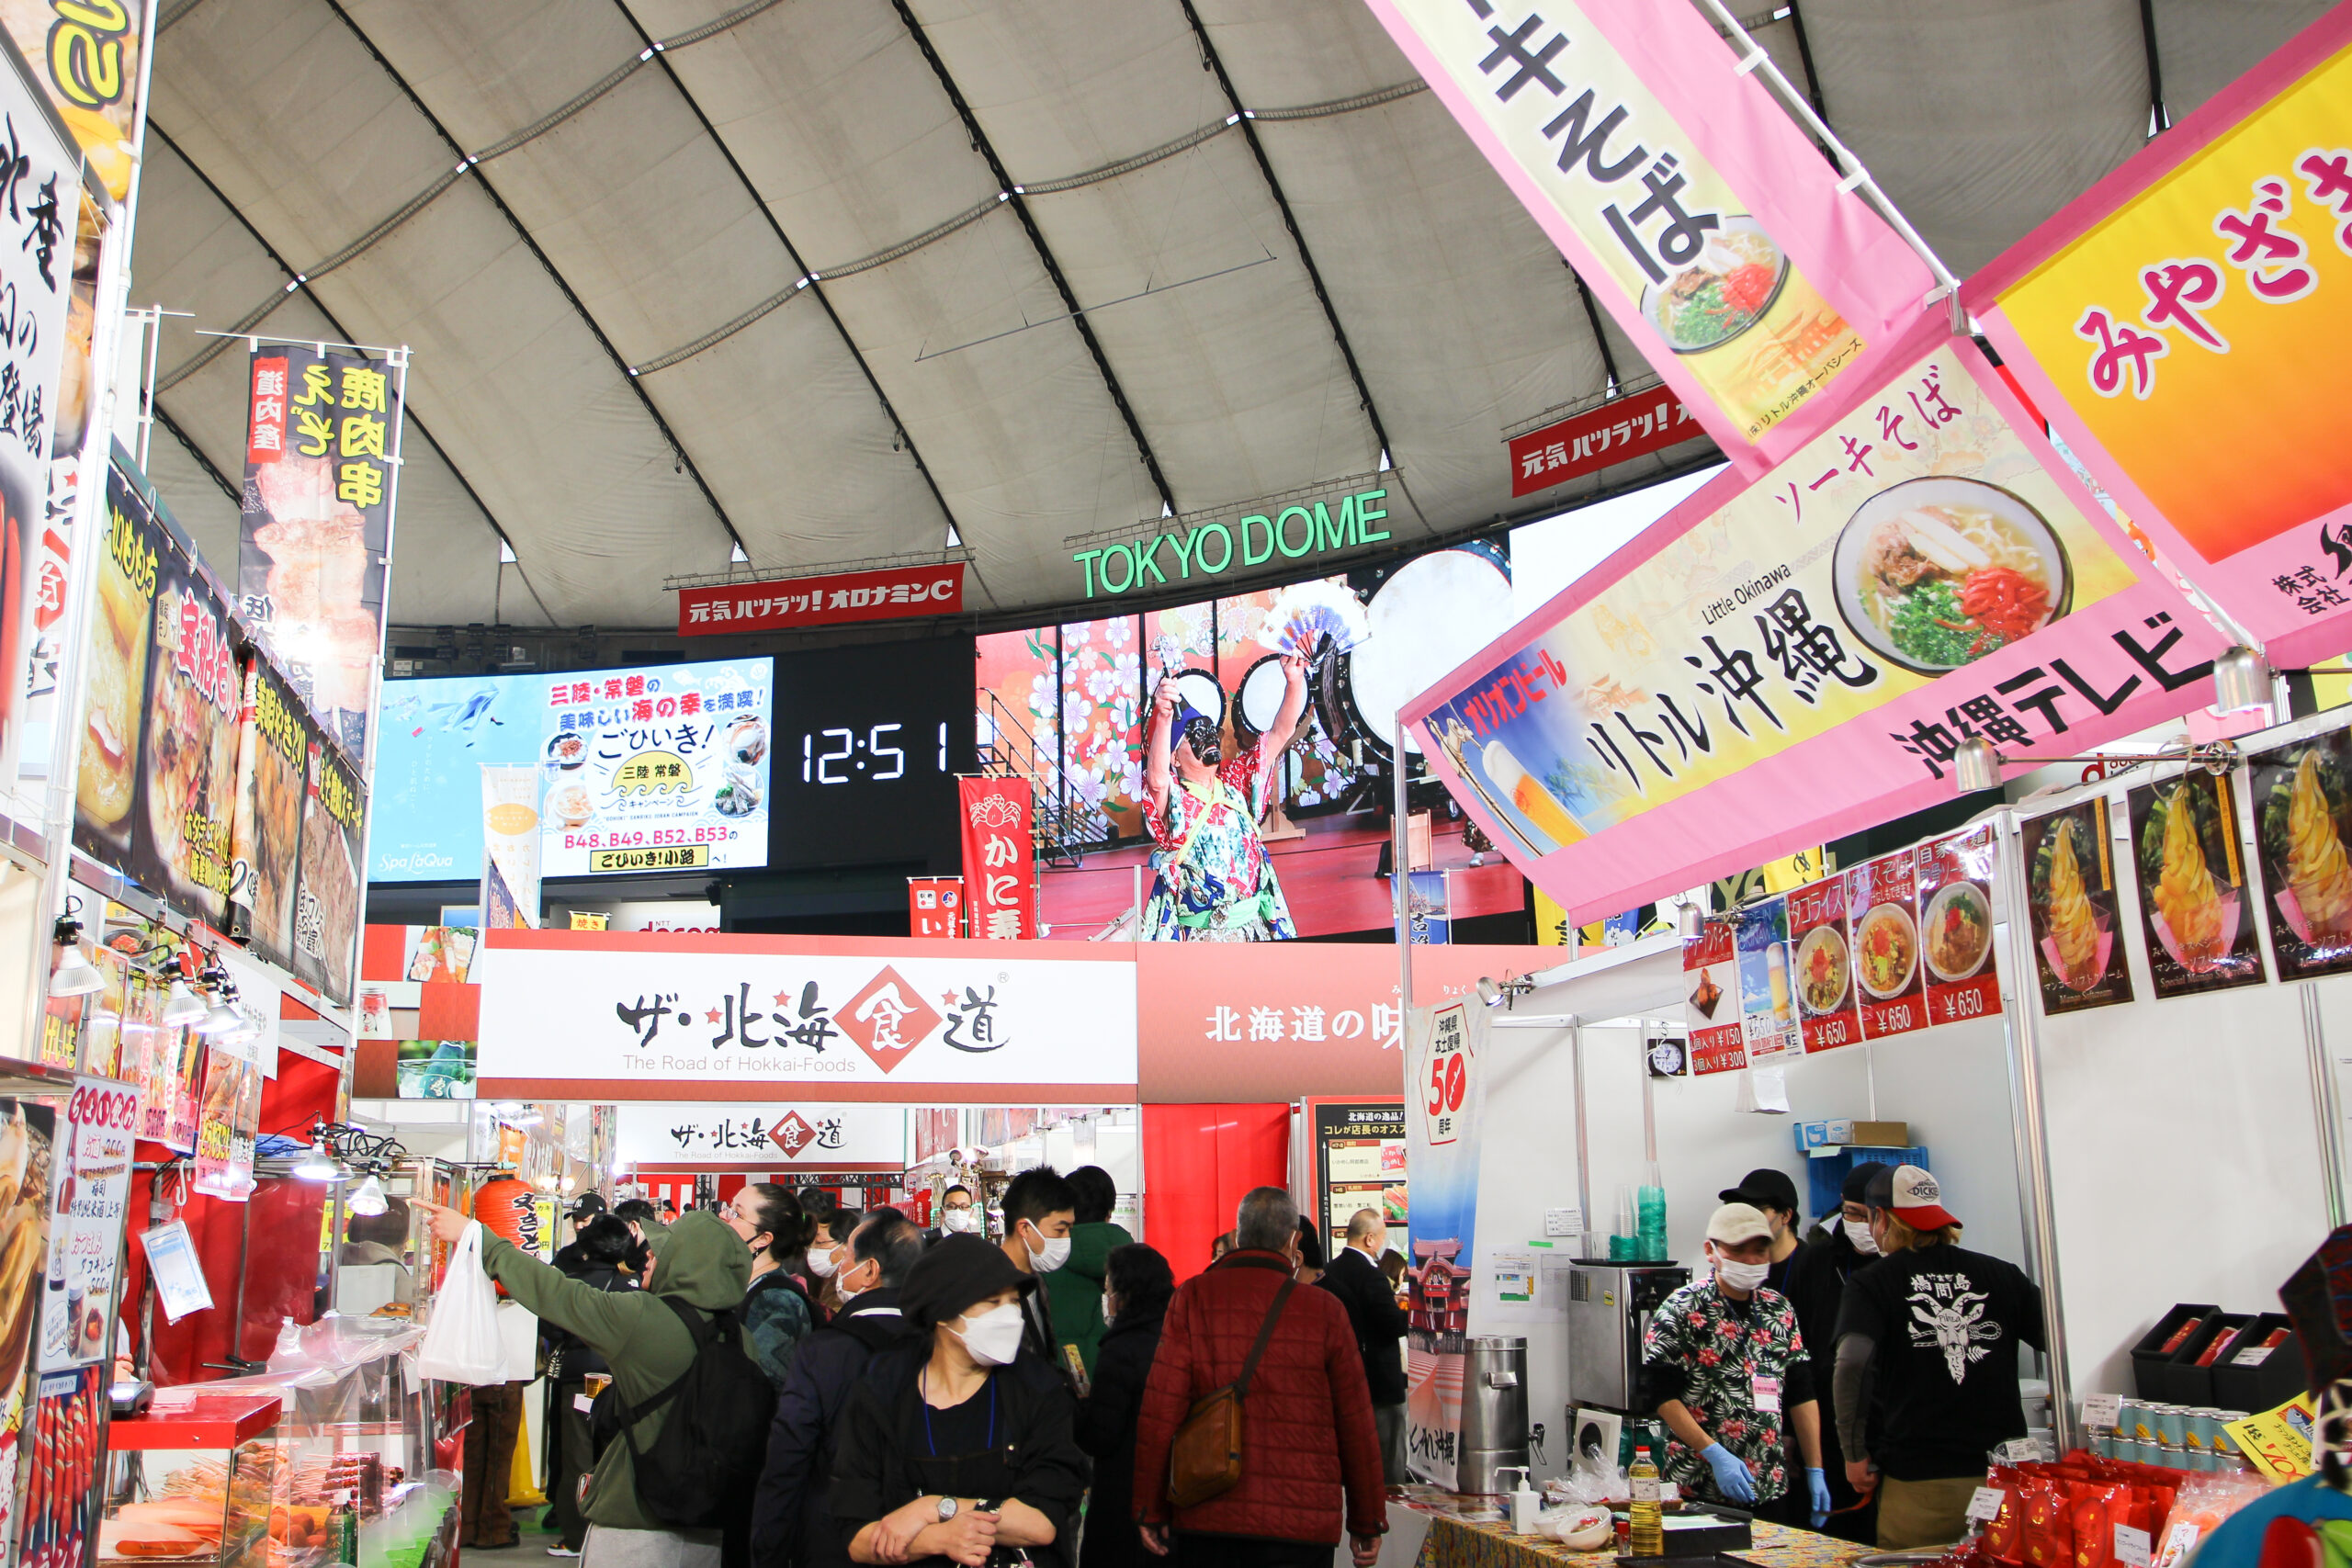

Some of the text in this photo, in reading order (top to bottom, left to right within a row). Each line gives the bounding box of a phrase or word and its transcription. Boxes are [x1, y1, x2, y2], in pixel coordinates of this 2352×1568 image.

[1773, 365, 1963, 525] ソーキそば
[1073, 489, 1391, 599] TOKYO DOME
[1702, 561, 1792, 626] Little Okinawa
[2270, 565, 2327, 597] 株式
[2297, 585, 2352, 615] 会社
[550, 674, 661, 707] 三陸・常磐の
[1464, 648, 1568, 738] オリオンビール
[1586, 588, 1879, 794] リトル沖縄
[1890, 611, 2216, 781] 沖縄テレビ
[597, 723, 715, 760] ごひいき!
[803, 721, 947, 784] 12:51
[628, 796, 674, 808] キャンペーン
[600, 848, 695, 869] ごひいき!小路
[1792, 885, 1845, 929] タコライス
[617, 980, 1012, 1055] ザ・北海食道
[1876, 1004, 1911, 1033] ¥650
[1944, 987, 1984, 1020] ¥650
[1439, 1014, 1458, 1036] 沖縄県
[1815, 1019, 1847, 1047] ¥650
[623, 1055, 856, 1074] The Road of Hokkai-Foods
[1429, 1053, 1466, 1117] 50
[1348, 1111, 1404, 1122] 北海道の逸品!
[671, 1117, 848, 1151] ザ・北海食道
[674, 1151, 778, 1161] The Road of Hokkai-Foods
